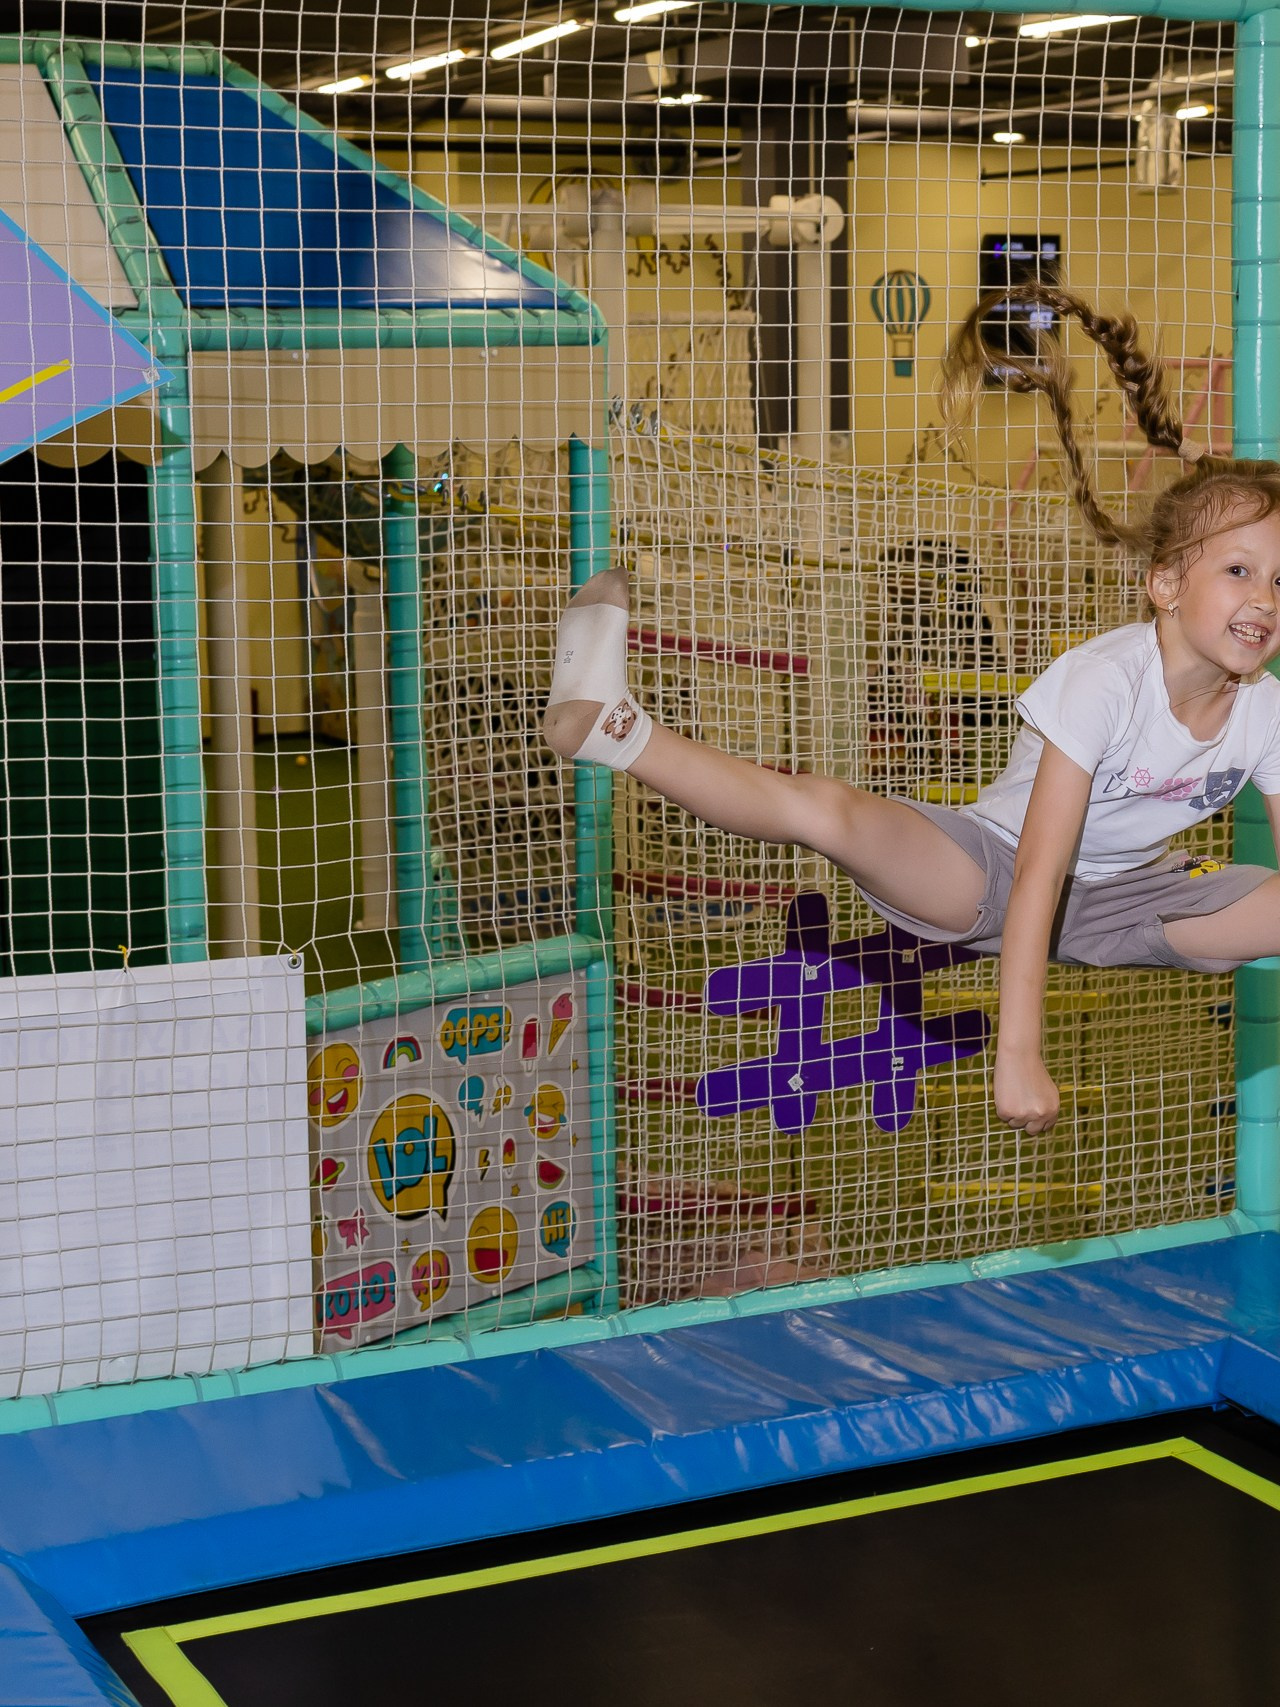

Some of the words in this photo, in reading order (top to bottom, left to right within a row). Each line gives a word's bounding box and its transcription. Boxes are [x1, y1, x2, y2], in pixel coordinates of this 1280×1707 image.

[440, 1009, 511, 1051] OOPS!
[373, 1115, 448, 1201] LOL
[543, 1208, 571, 1245] Hi!
[317, 1270, 397, 1323] XOXO!
